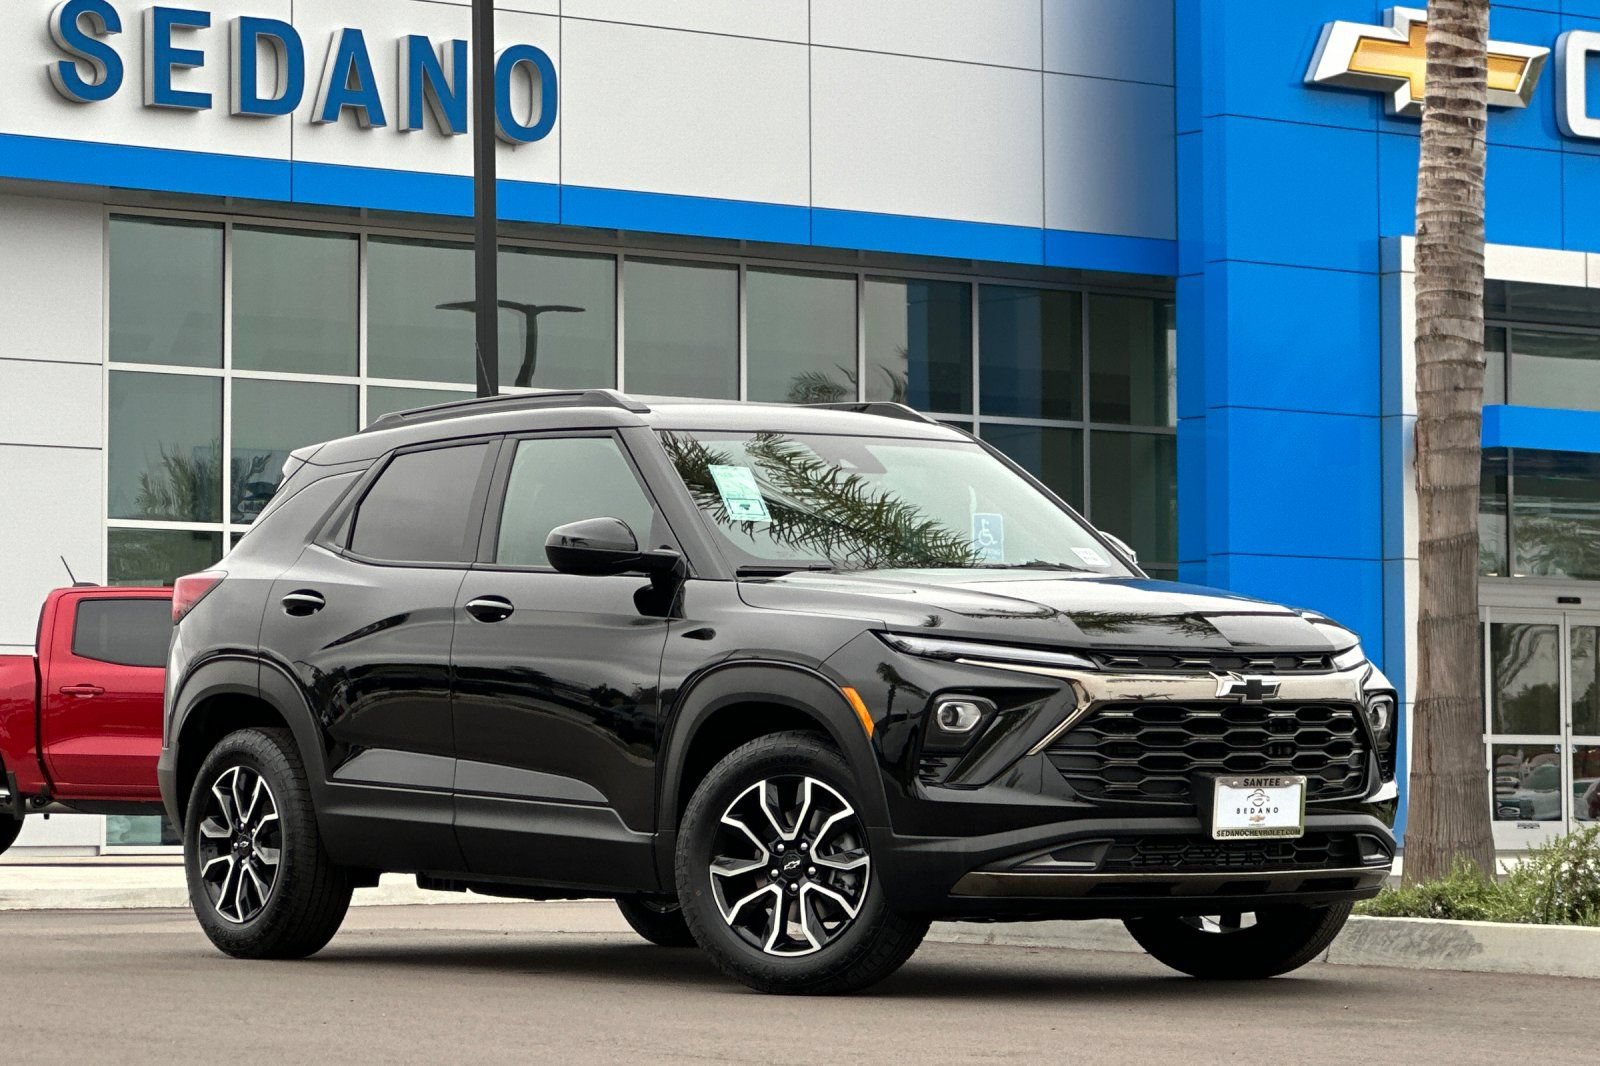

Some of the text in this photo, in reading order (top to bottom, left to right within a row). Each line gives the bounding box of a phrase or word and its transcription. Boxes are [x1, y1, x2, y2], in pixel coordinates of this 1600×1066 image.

[50, 0, 558, 144] SEDANO
[1243, 778, 1281, 787] SANTEE
[1216, 829, 1301, 837] SEDANOCHEVROLET.COM
